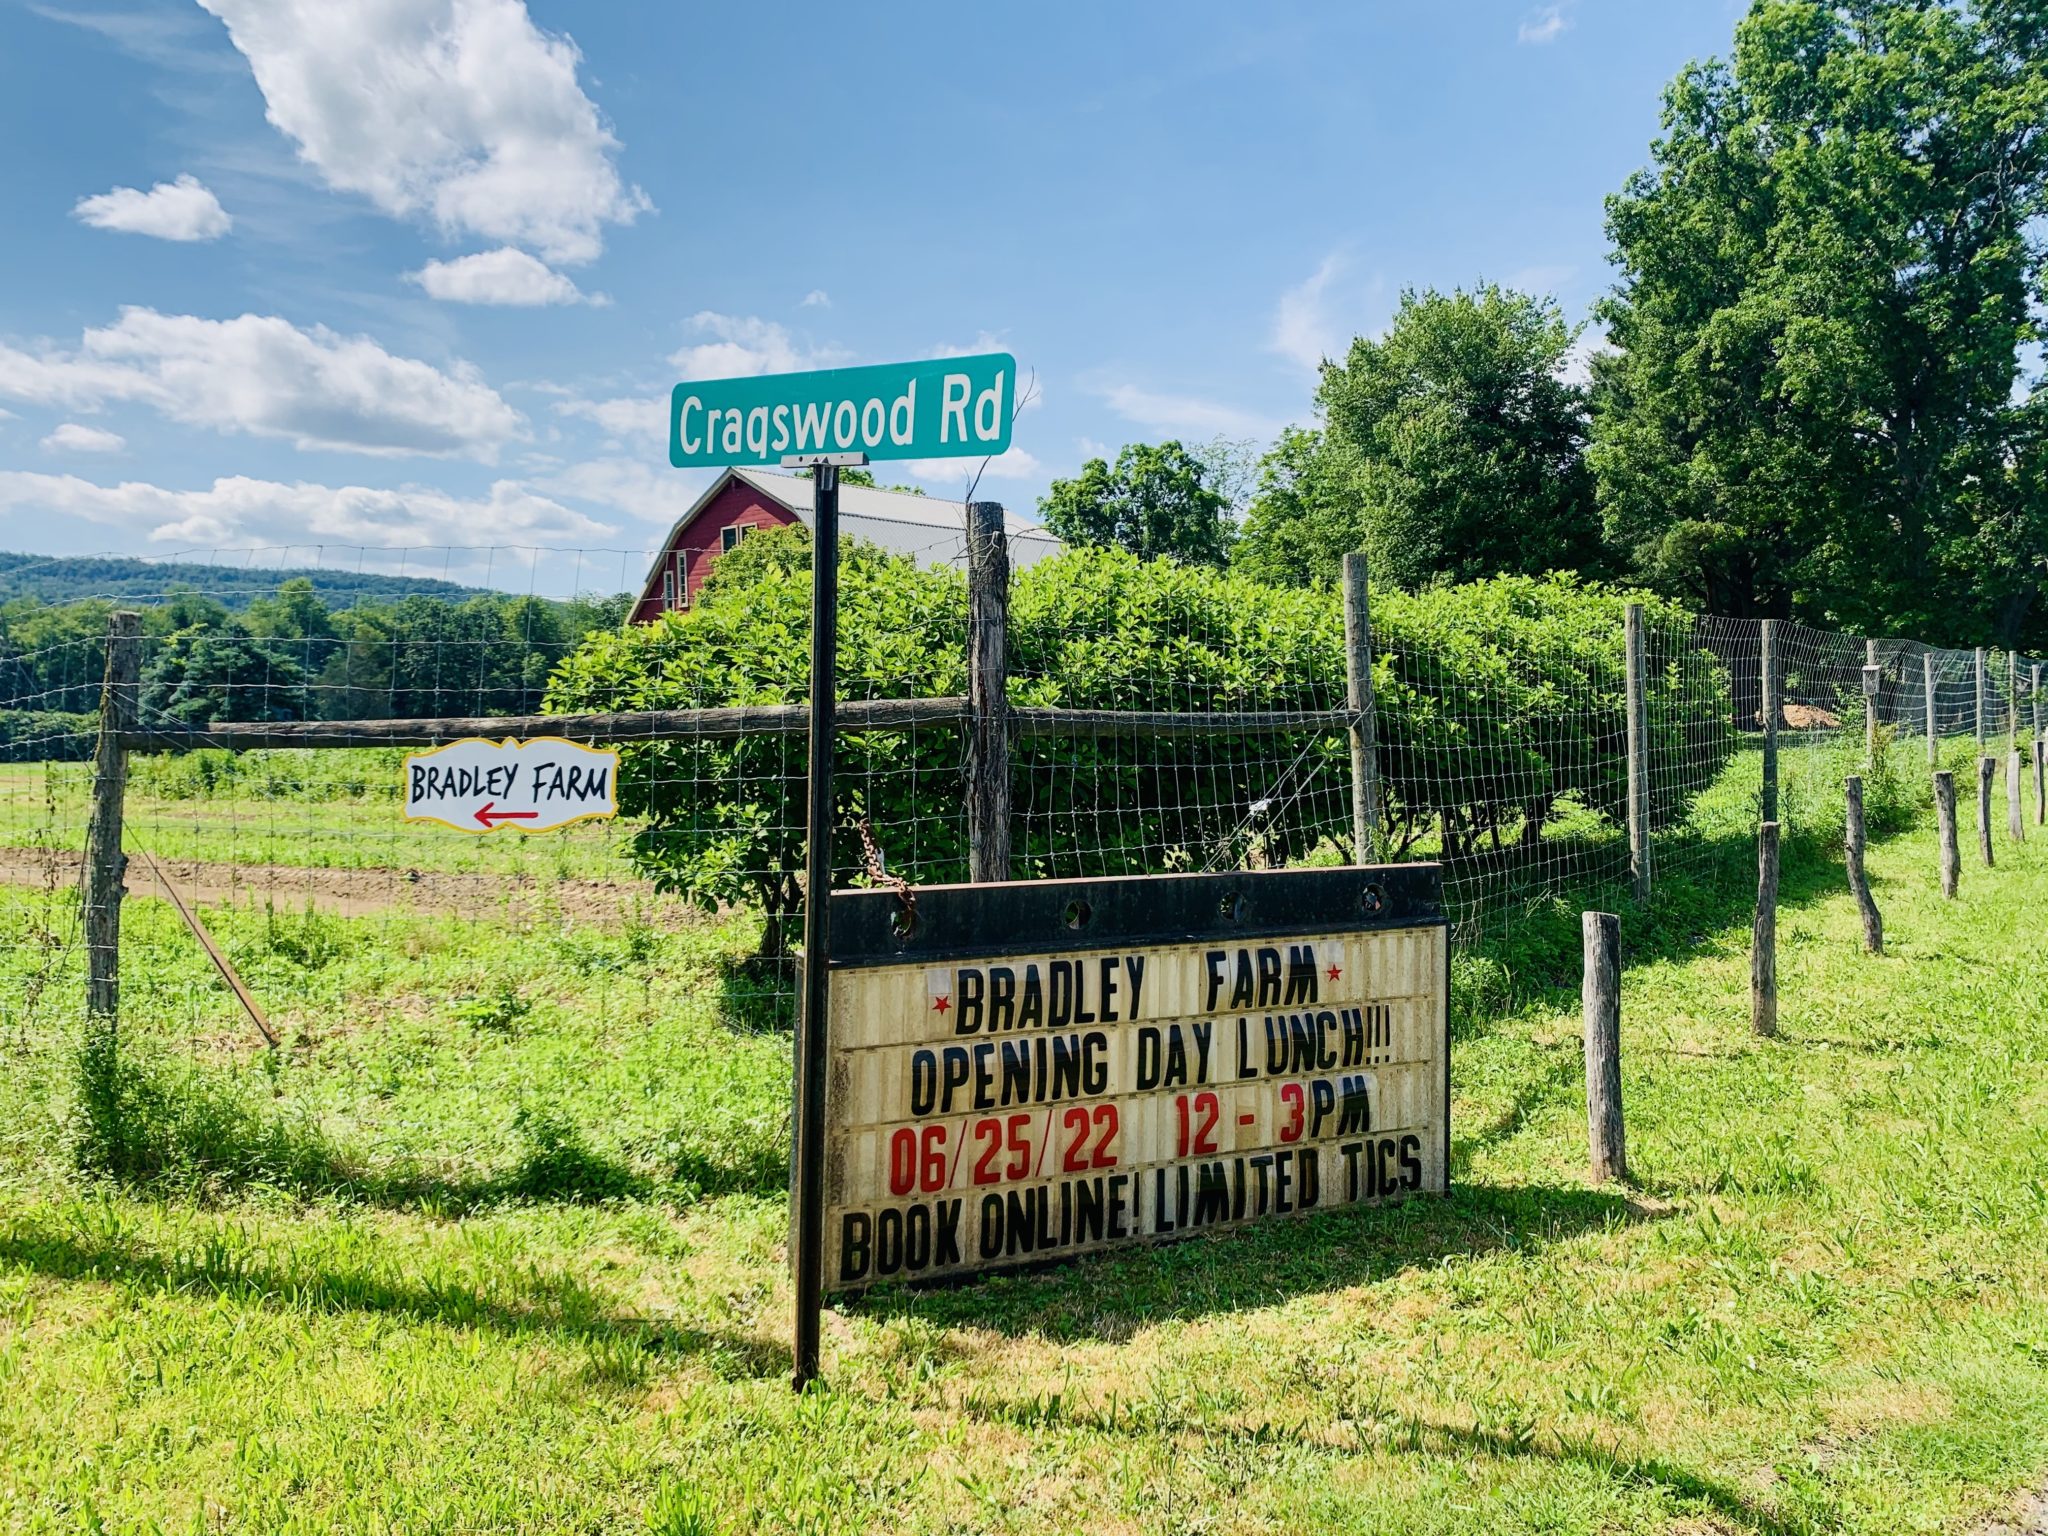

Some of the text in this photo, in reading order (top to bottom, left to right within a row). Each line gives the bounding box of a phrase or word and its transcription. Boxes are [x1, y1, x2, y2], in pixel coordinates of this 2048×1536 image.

[940, 370, 1004, 443] Rd
[411, 762, 607, 803] BRADLEY FARM
[955, 945, 1319, 1035] BRADLEY FARM
[911, 1003, 1391, 1116] OPENING DAY LUNCH!!!
[890, 1104, 1118, 1196] 06/25/22
[1176, 1092, 1220, 1157] 12
[1280, 1075, 1370, 1143] 3PM
[840, 1134, 1421, 1282] BOOK ONLINE! LIMITED TICS
